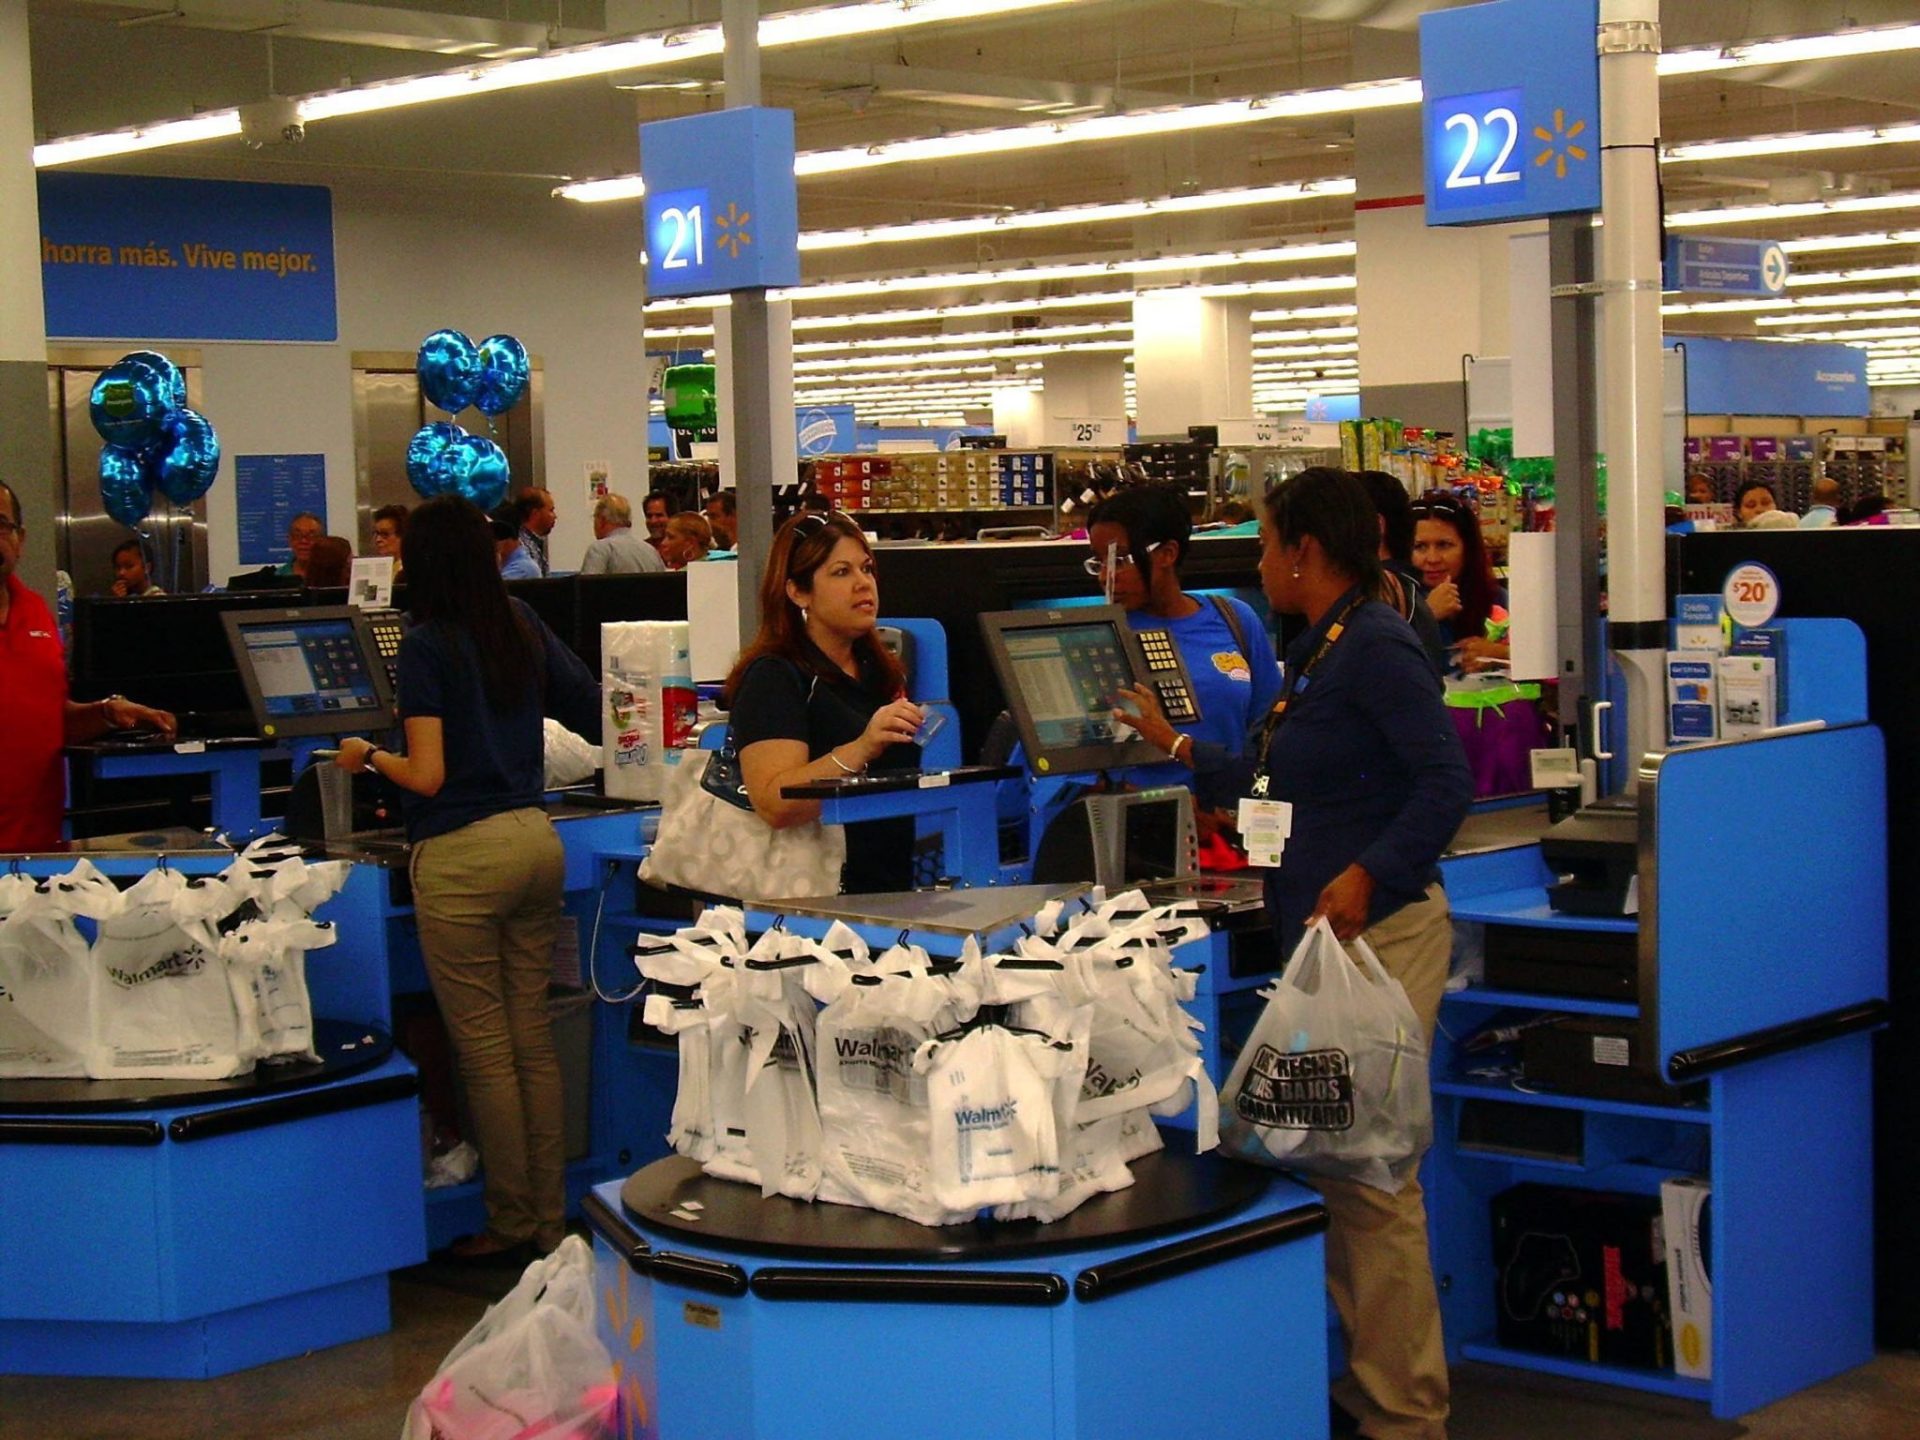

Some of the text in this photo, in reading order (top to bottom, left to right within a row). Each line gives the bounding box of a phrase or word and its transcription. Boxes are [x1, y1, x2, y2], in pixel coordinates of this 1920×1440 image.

[1445, 107, 1520, 189] 22
[661, 204, 703, 269] 21
[119, 241, 178, 268] más.
[182, 243, 236, 269] Vive
[243, 248, 317, 278] mejor.
[106, 951, 183, 985] Walmart
[1280, 1079, 1341, 1101] BAJOS
[1239, 1095, 1349, 1125] GARANTIZADO
